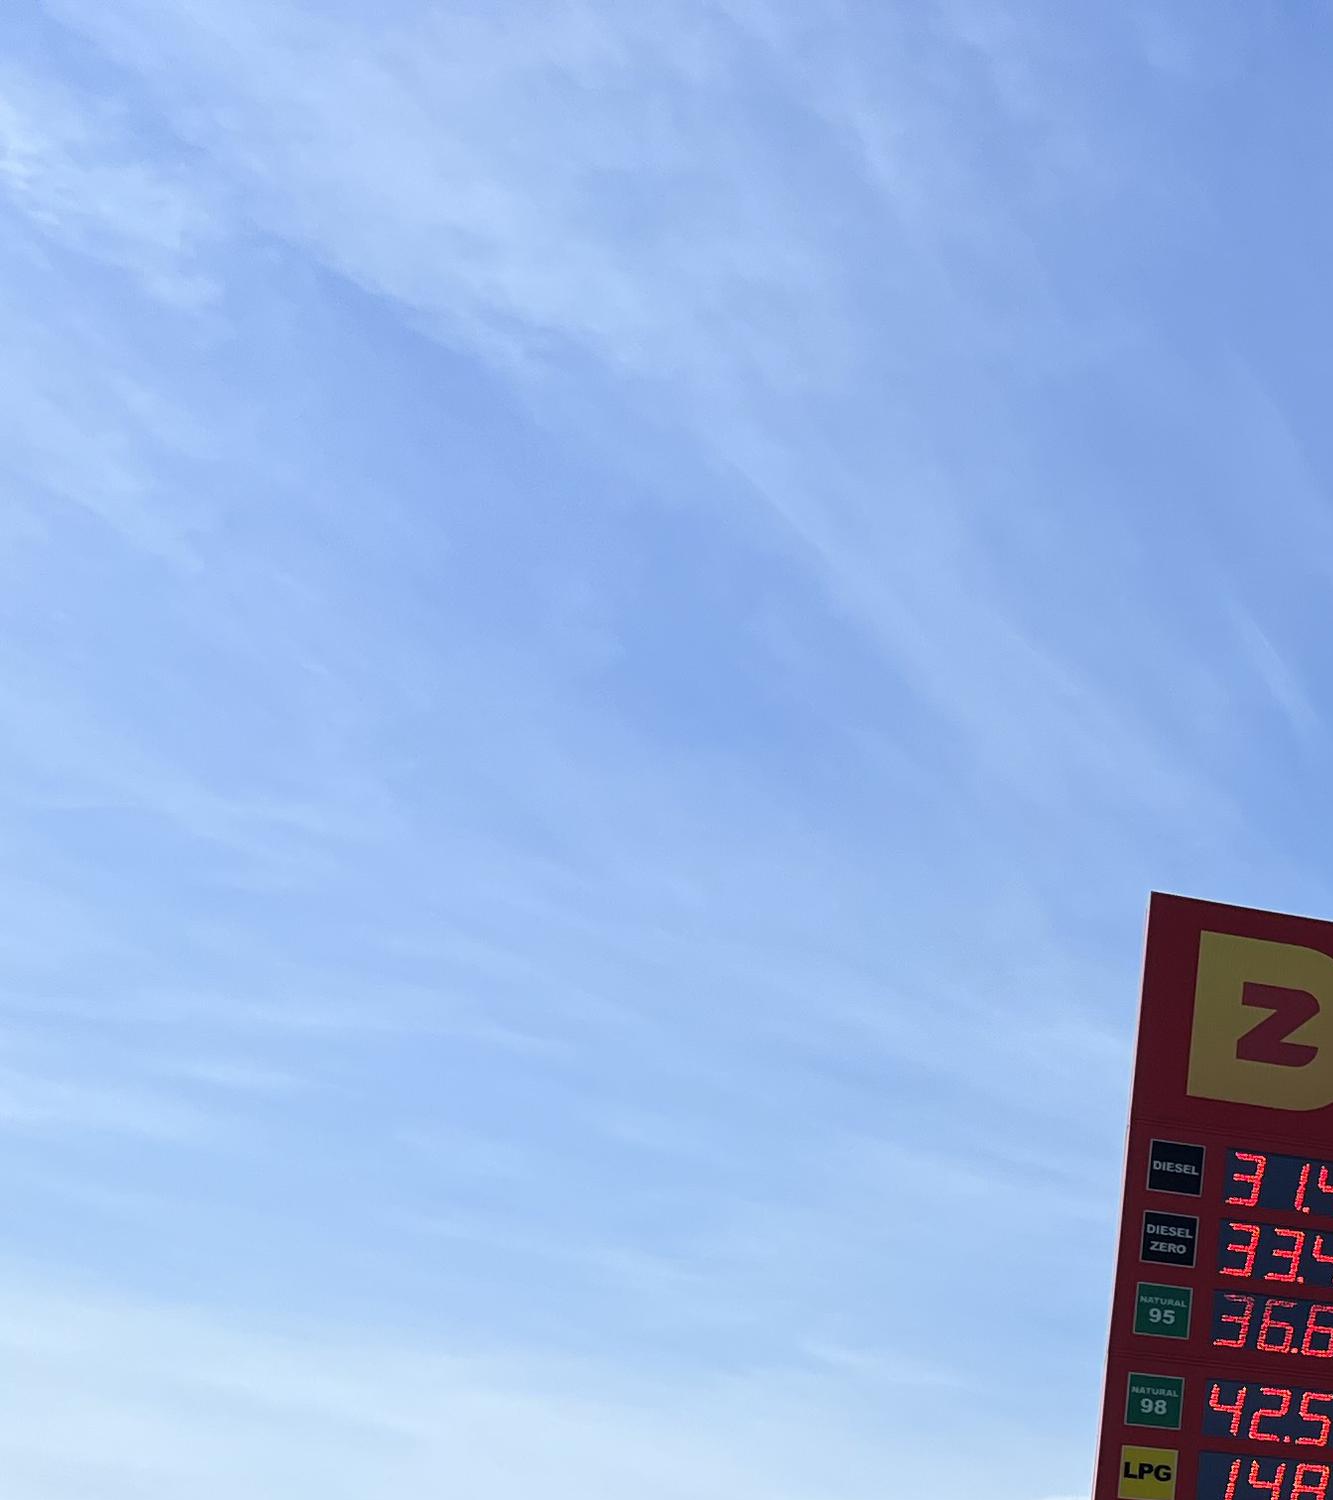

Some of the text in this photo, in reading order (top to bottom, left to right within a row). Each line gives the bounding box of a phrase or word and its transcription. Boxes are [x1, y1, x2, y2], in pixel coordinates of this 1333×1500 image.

[1153, 1159, 1199, 1176] DIESEL
[1146, 1223, 1193, 1239] DIESEL
[1149, 1240, 1187, 1255] ZERO
[1139, 1294, 1188, 1308] NATURAL
[1149, 1307, 1176, 1325] 95
[1131, 1384, 1179, 1398] NATURAL
[1140, 1398, 1168, 1416] 98
[1123, 1461, 1172, 1482] LPG
